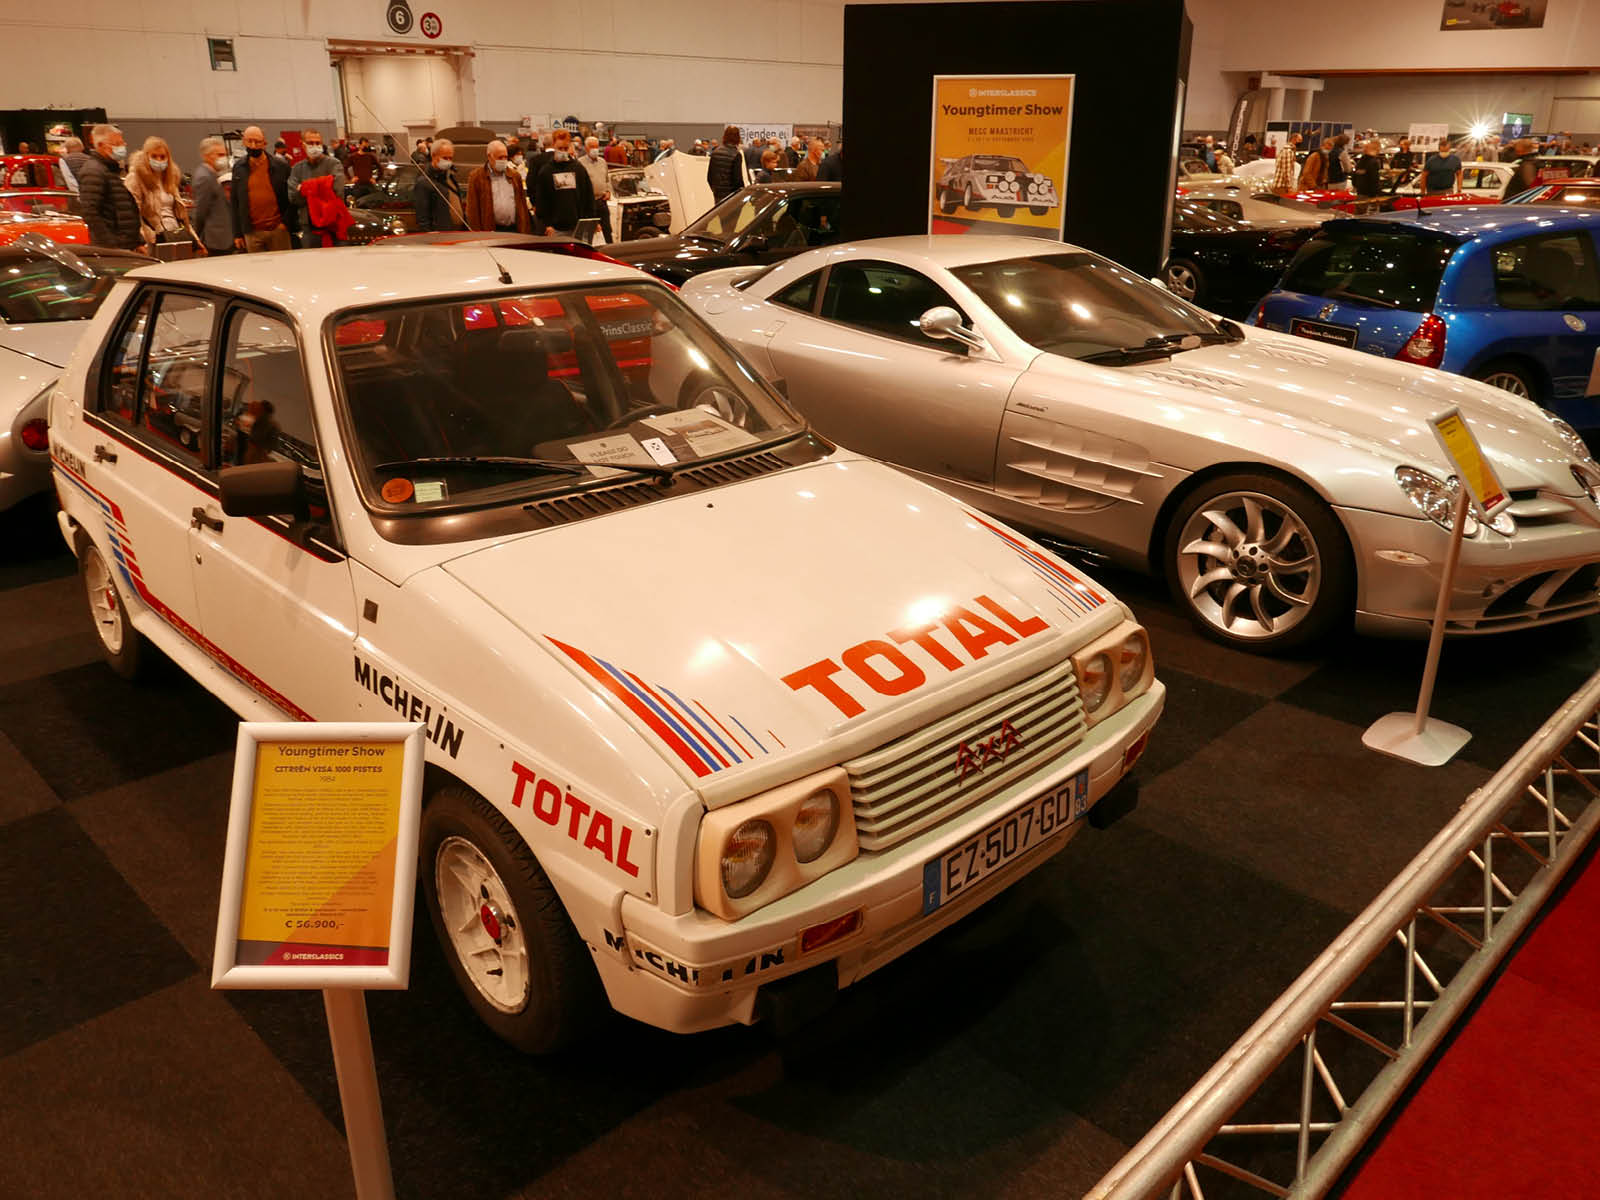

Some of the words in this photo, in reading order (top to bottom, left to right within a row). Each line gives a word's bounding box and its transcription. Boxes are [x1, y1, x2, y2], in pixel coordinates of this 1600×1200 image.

[395, 11, 405, 25] 6
[942, 104, 1023, 118] Youngtimer
[1024, 104, 1064, 116] Show
[968, 127, 988, 136] MECC
[990, 127, 1034, 136] MAASTRICHT
[780, 594, 1051, 719] TOTAL
[353, 655, 465, 760] MICHELIN
[278, 746, 350, 758] Youngtimer
[351, 745, 385, 757] Show
[274, 764, 311, 773] CITROËN
[312, 765, 333, 773] VISA
[335, 765, 351, 773] 1000
[353, 765, 383, 773] PISTES
[511, 760, 640, 878] TOTAL
[291, 952, 344, 961] INTERCLASSICS
